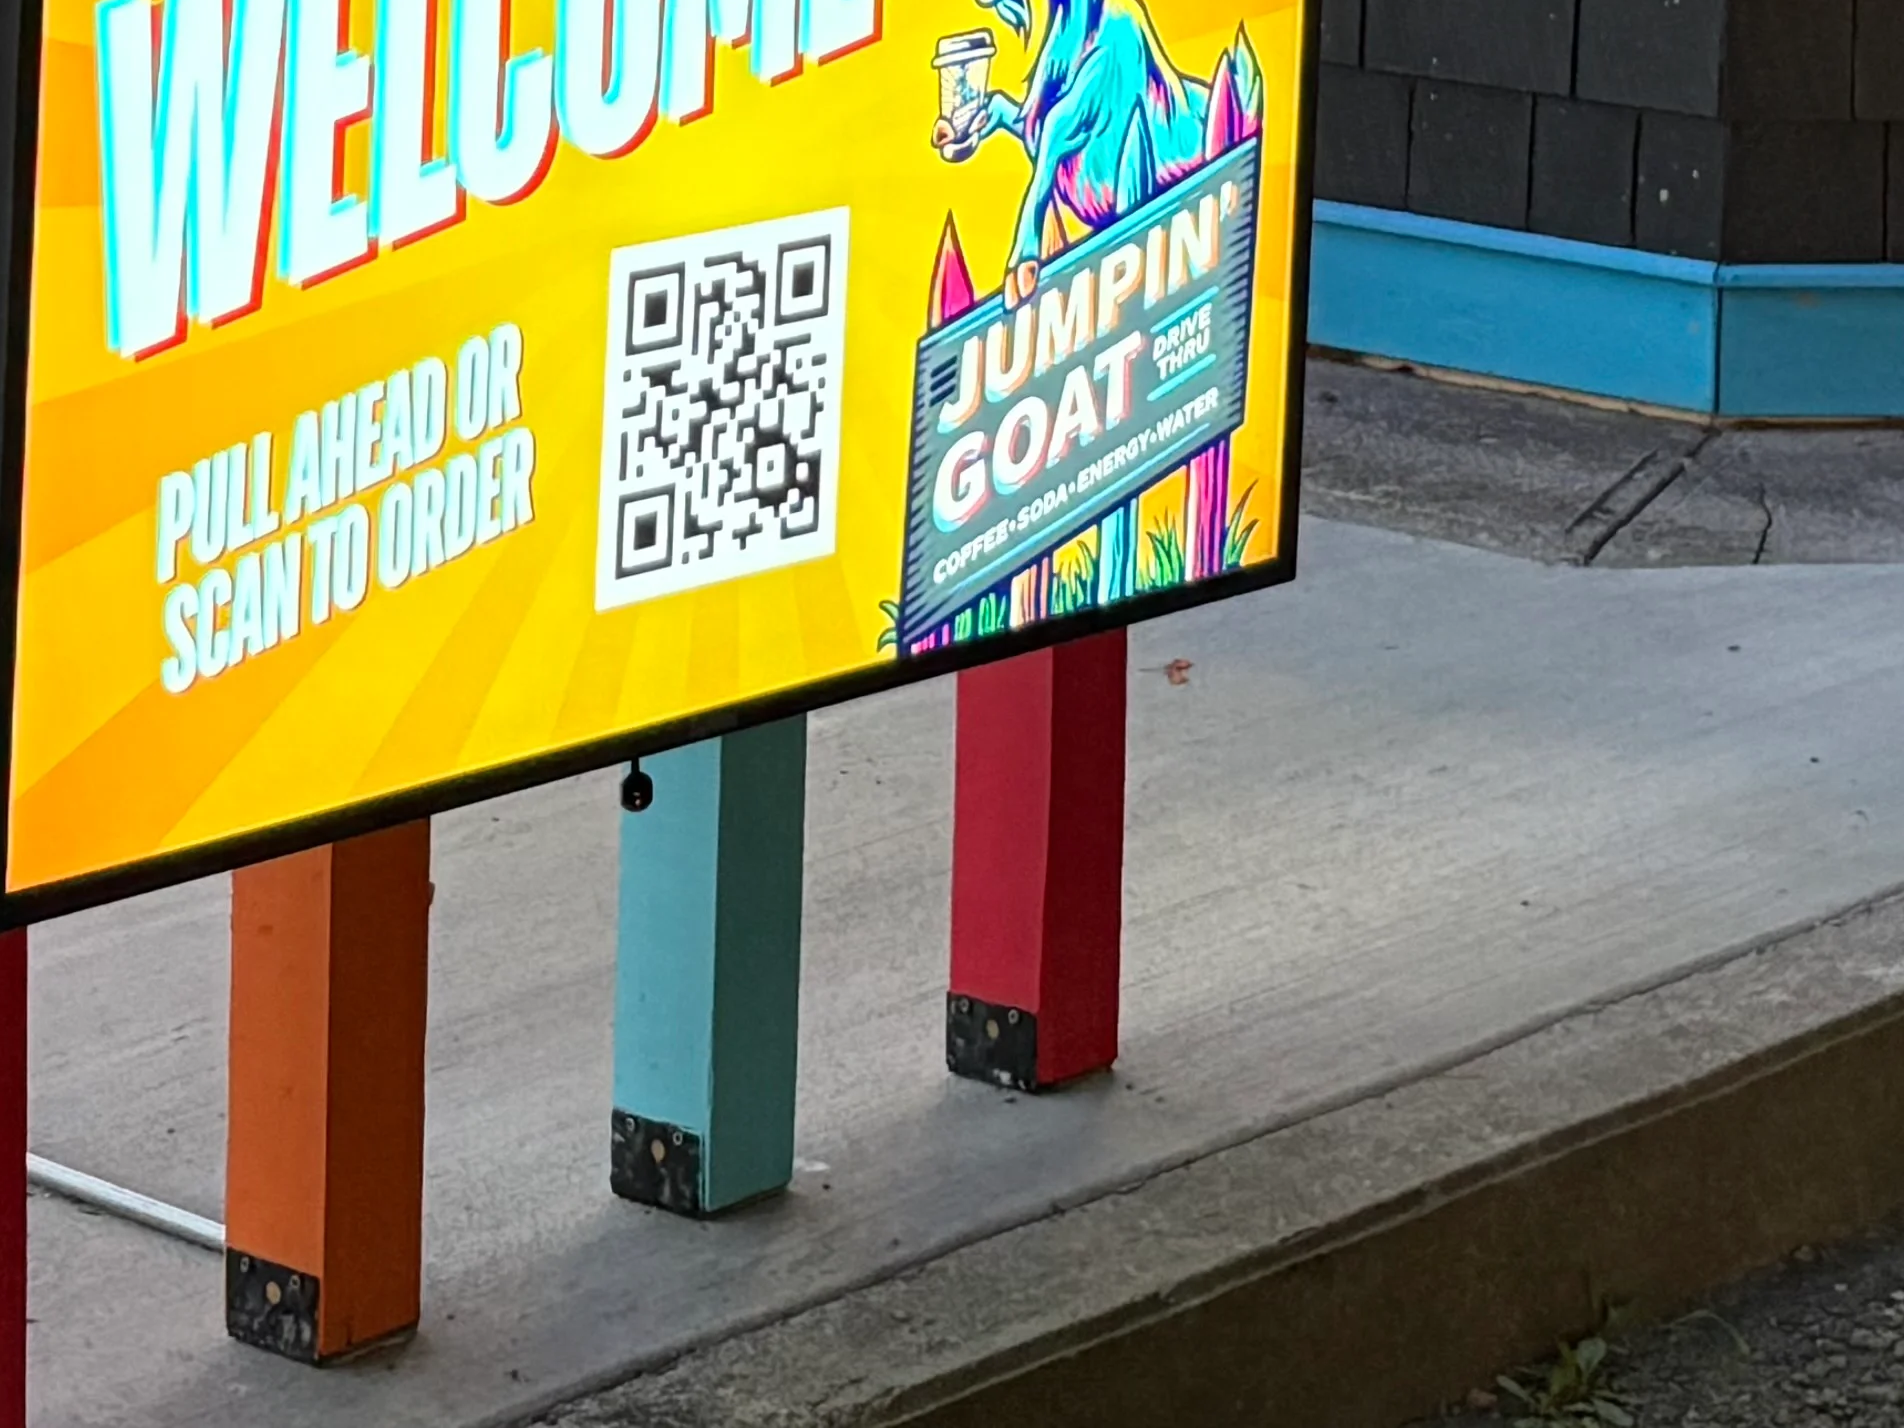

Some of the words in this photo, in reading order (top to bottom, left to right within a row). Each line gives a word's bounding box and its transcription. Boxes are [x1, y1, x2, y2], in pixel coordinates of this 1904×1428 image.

[937, 180, 1238, 434] JUMPIN'
[1152, 302, 1212, 361] DRIVE
[1156, 327, 1212, 381] THRU
[156, 431, 280, 584] PULL
[283, 355, 449, 526] AHEAD
[454, 321, 524, 442] OR
[932, 330, 1146, 533] GOAT
[932, 520, 1010, 585] COFFEE
[1015, 483, 1069, 531] SODA
[1076, 435, 1151, 493] ENERGY
[1156, 387, 1219, 442] WATER
[161, 531, 303, 695] SCAN
[307, 502, 371, 626] TO
[376, 426, 537, 590] ORDER
